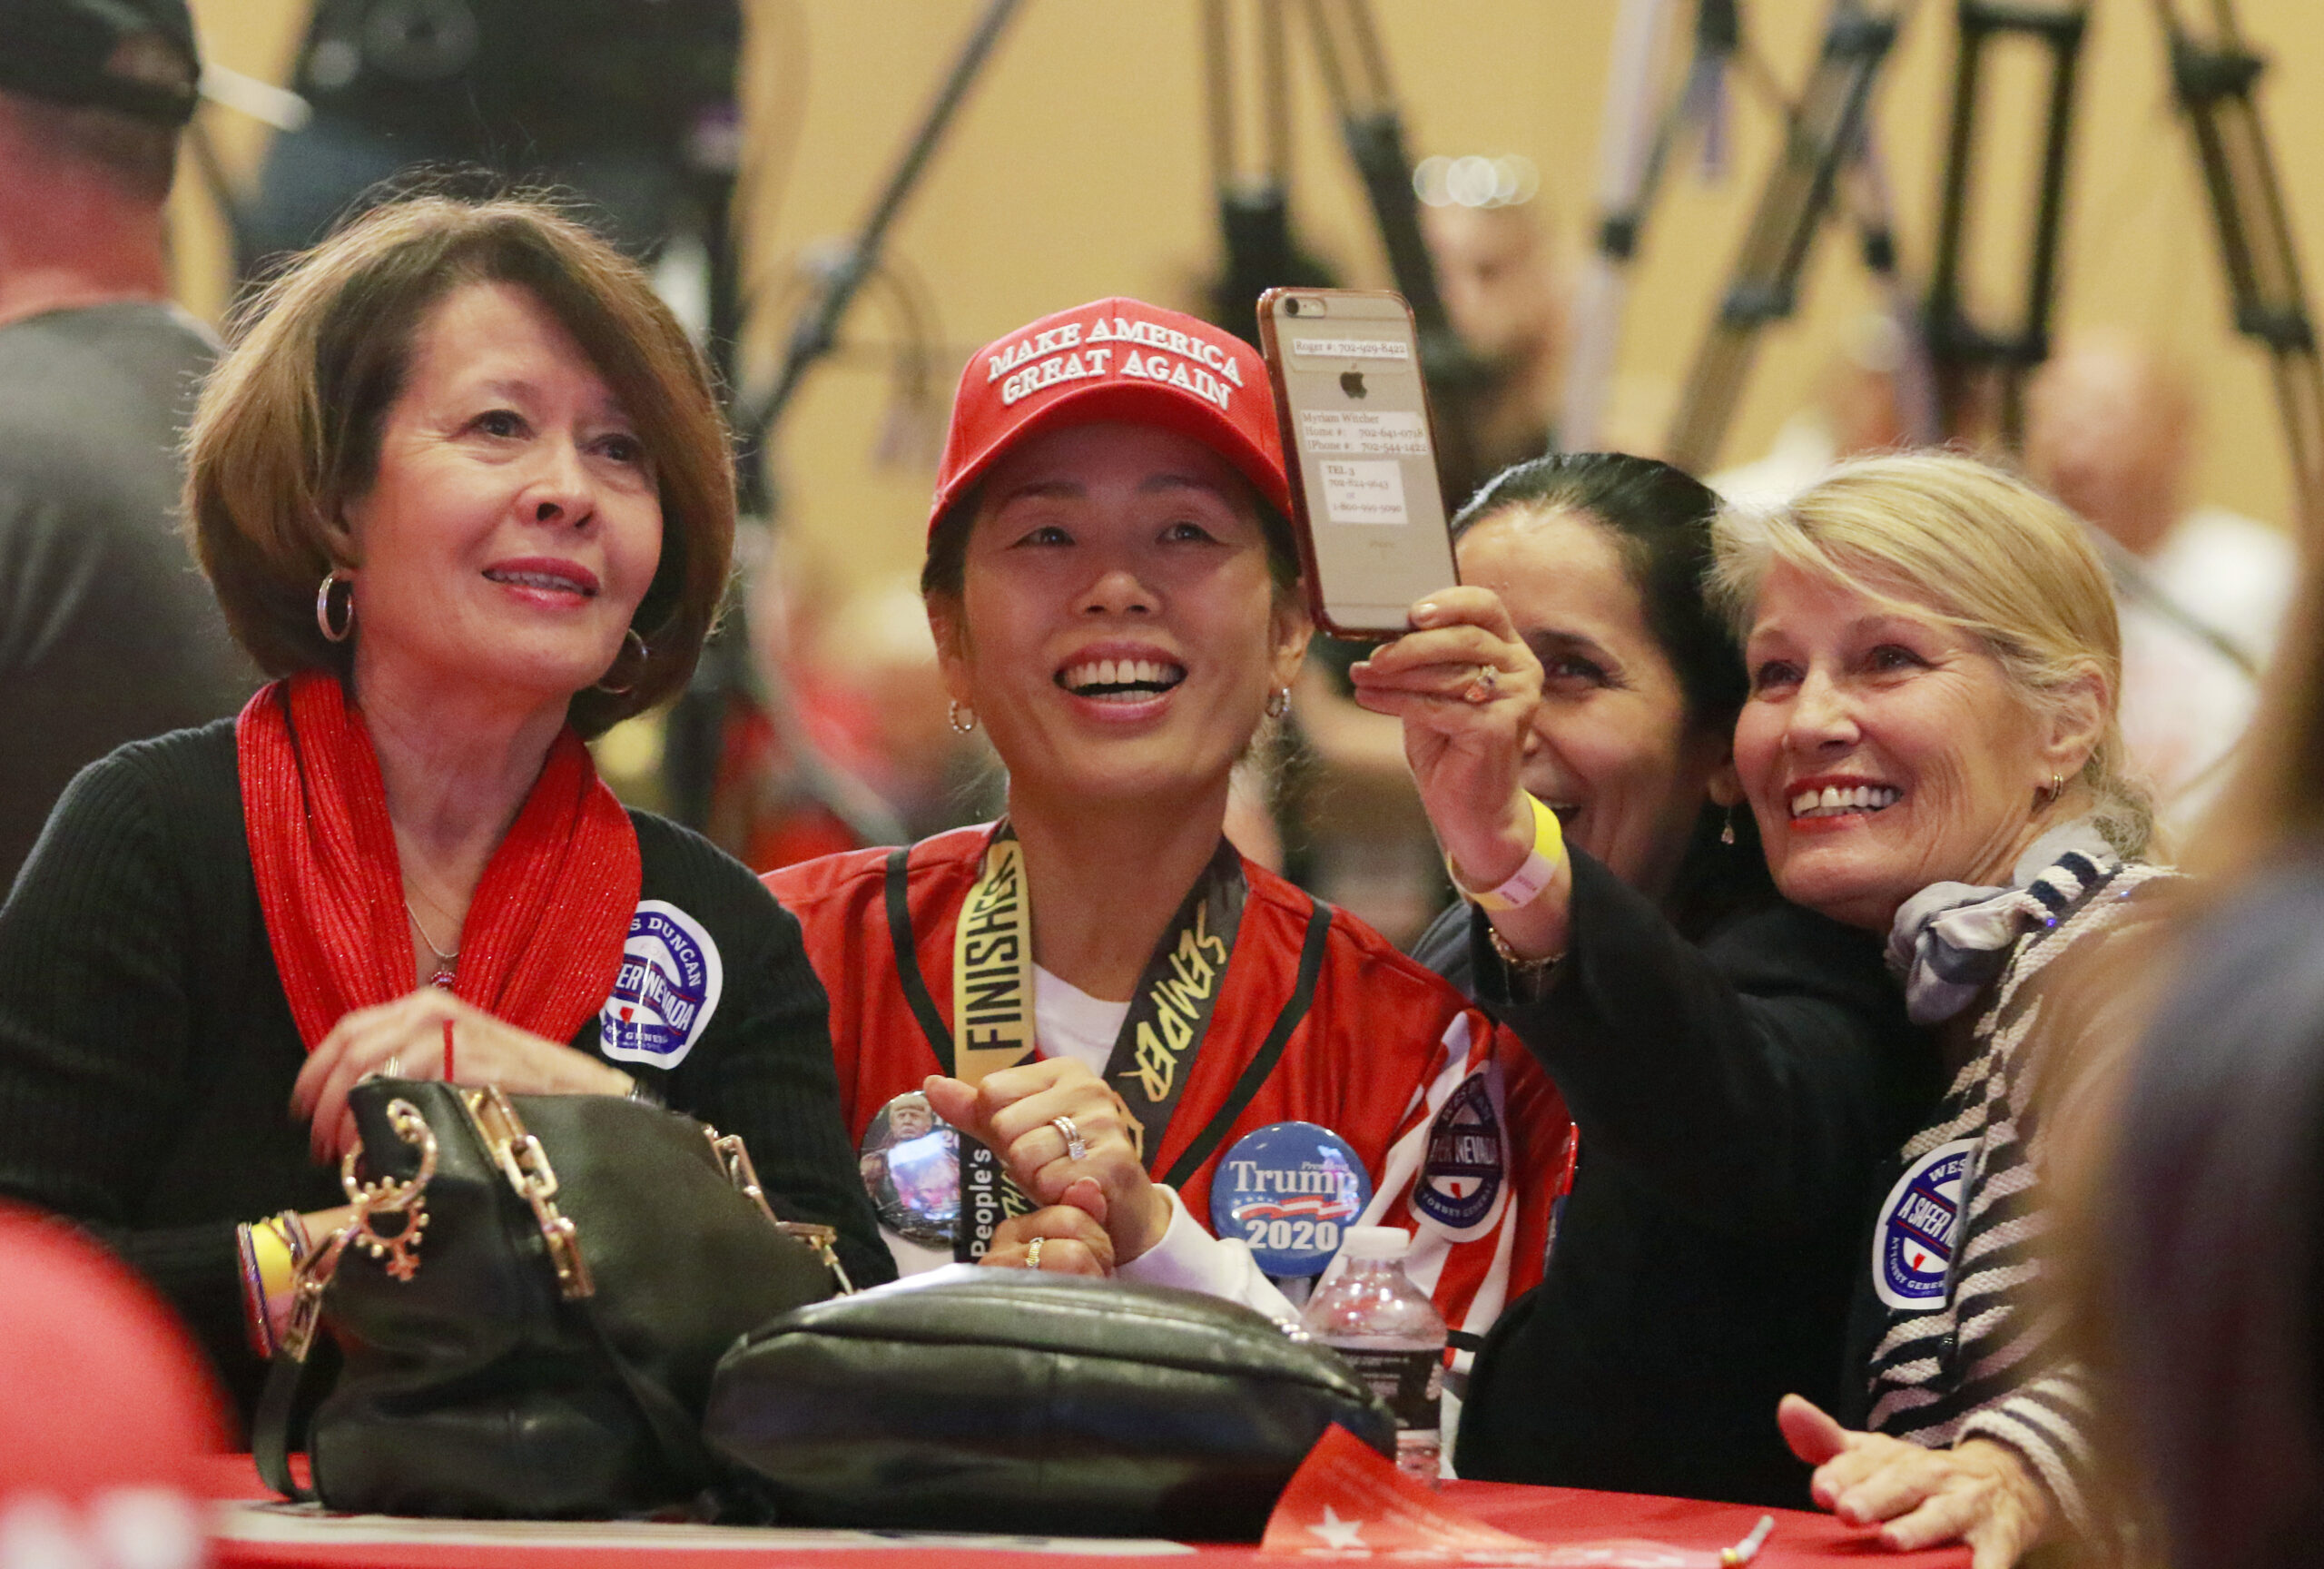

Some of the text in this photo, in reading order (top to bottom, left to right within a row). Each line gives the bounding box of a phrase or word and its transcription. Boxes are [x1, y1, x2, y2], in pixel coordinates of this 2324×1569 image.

[988, 318, 1244, 387] MAKE AMERICA
[1002, 349, 1231, 411] GREAT AGAIN
[1305, 426, 1333, 437] Home
[647, 917, 702, 988] DUNCAN
[643, 972, 695, 1031] NEVADA
[968, 1149, 998, 1257] People's
[1229, 1160, 1359, 1203] Trump
[1246, 1220, 1339, 1250] 2020
[1907, 1197, 1951, 1238] SAFER
